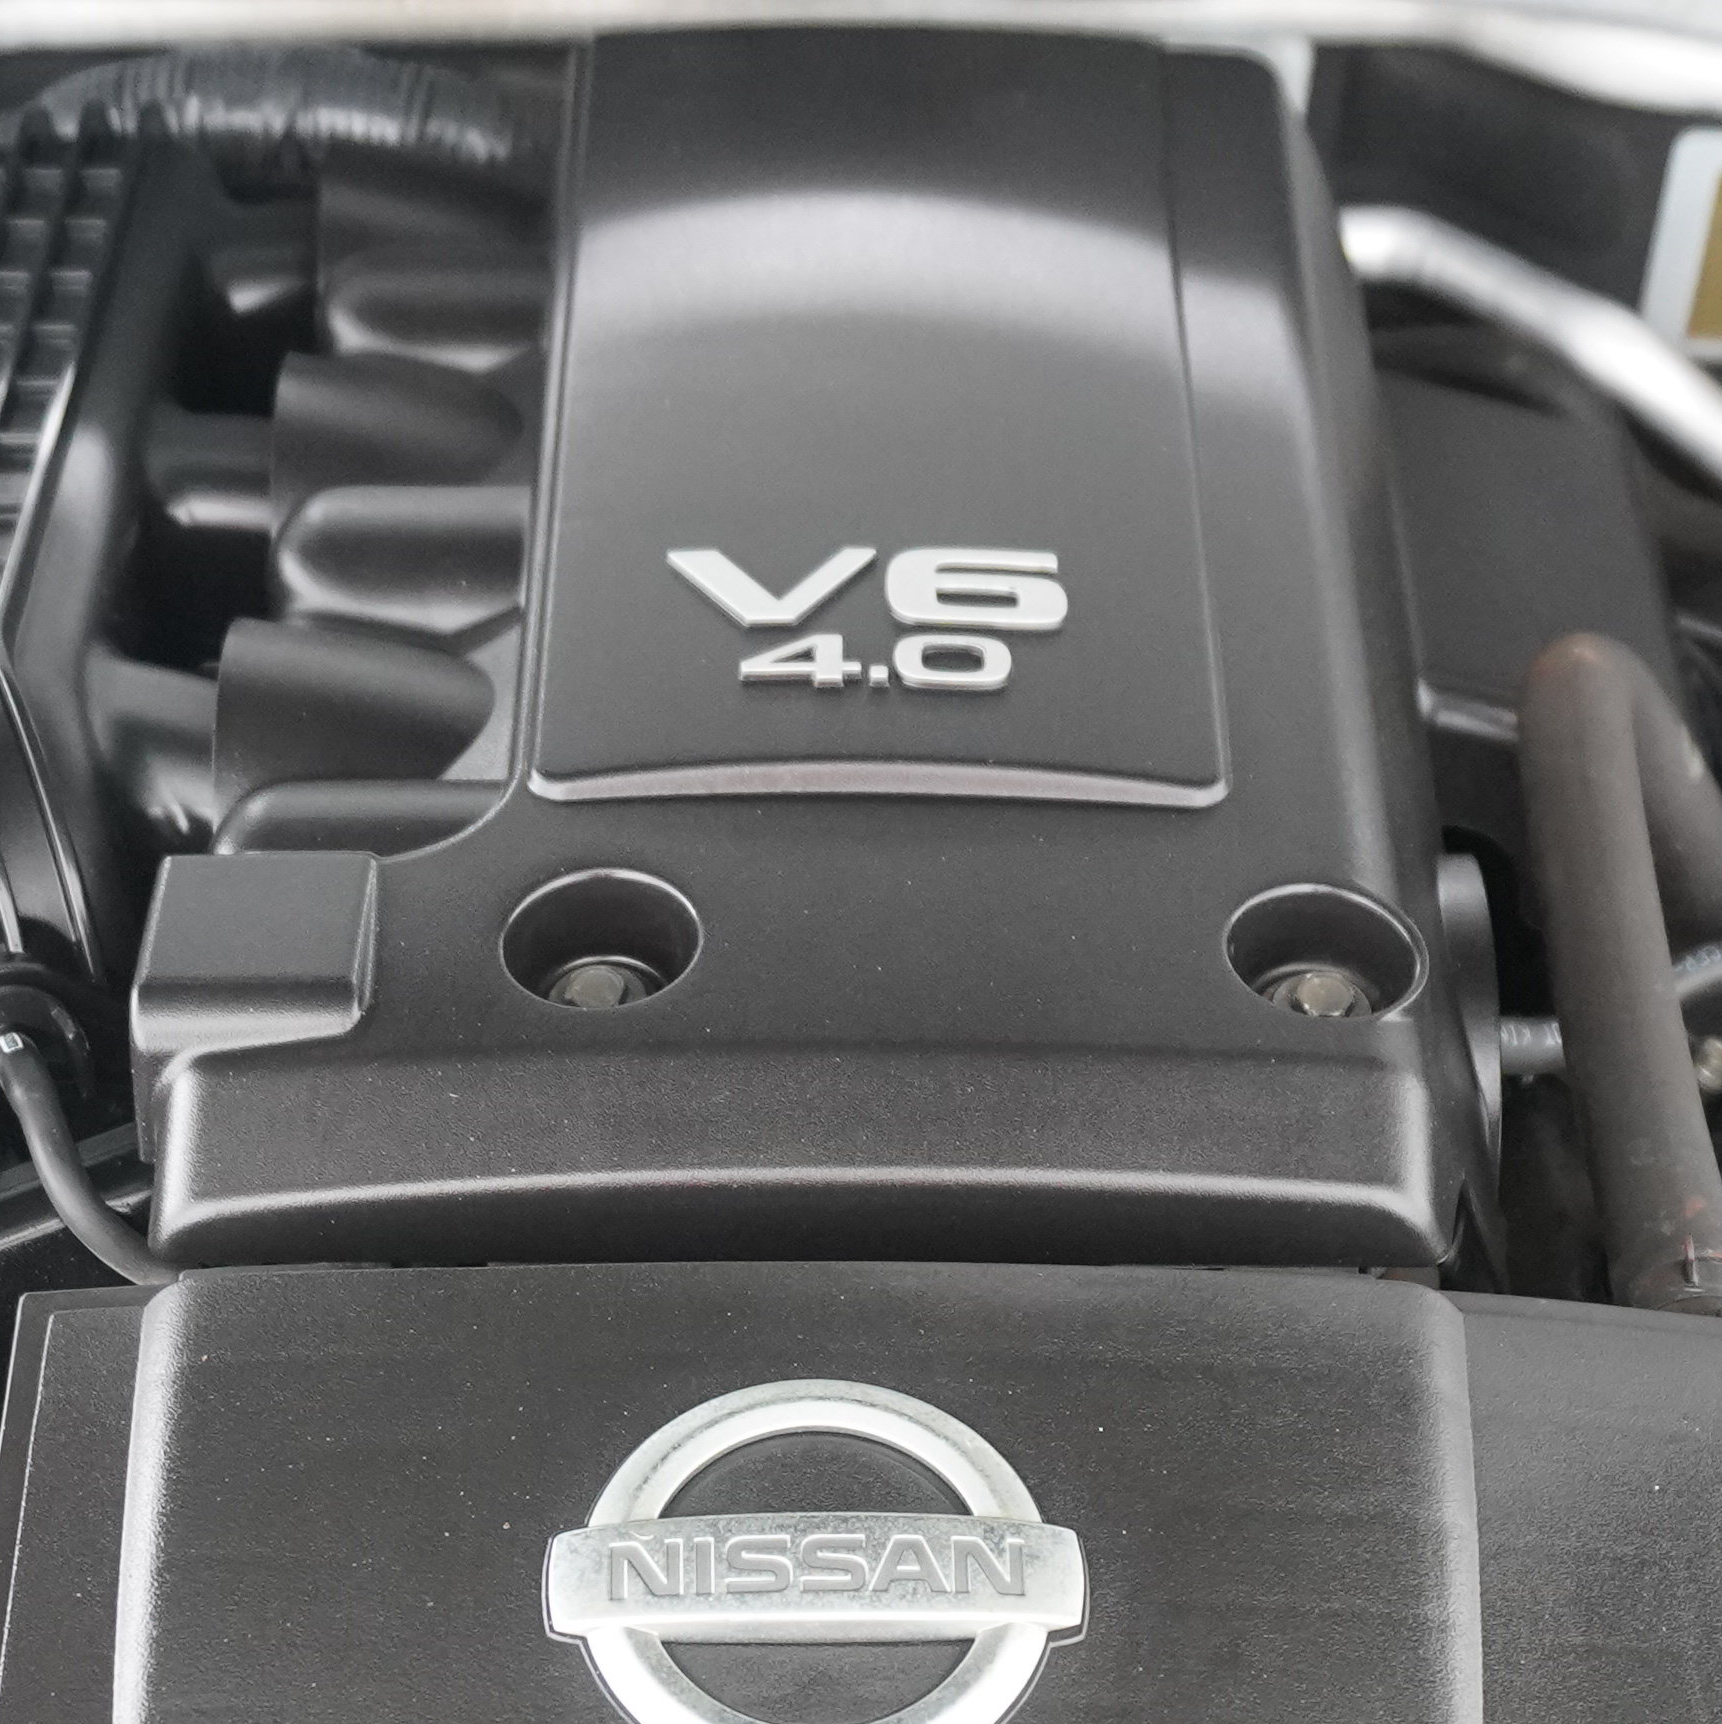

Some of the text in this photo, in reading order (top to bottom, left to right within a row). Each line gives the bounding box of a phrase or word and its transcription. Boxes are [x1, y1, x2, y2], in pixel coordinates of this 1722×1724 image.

[666, 546, 1069, 631] V6
[737, 632, 1013, 691] 4.0
[607, 1533, 1026, 1602] NISSAN
